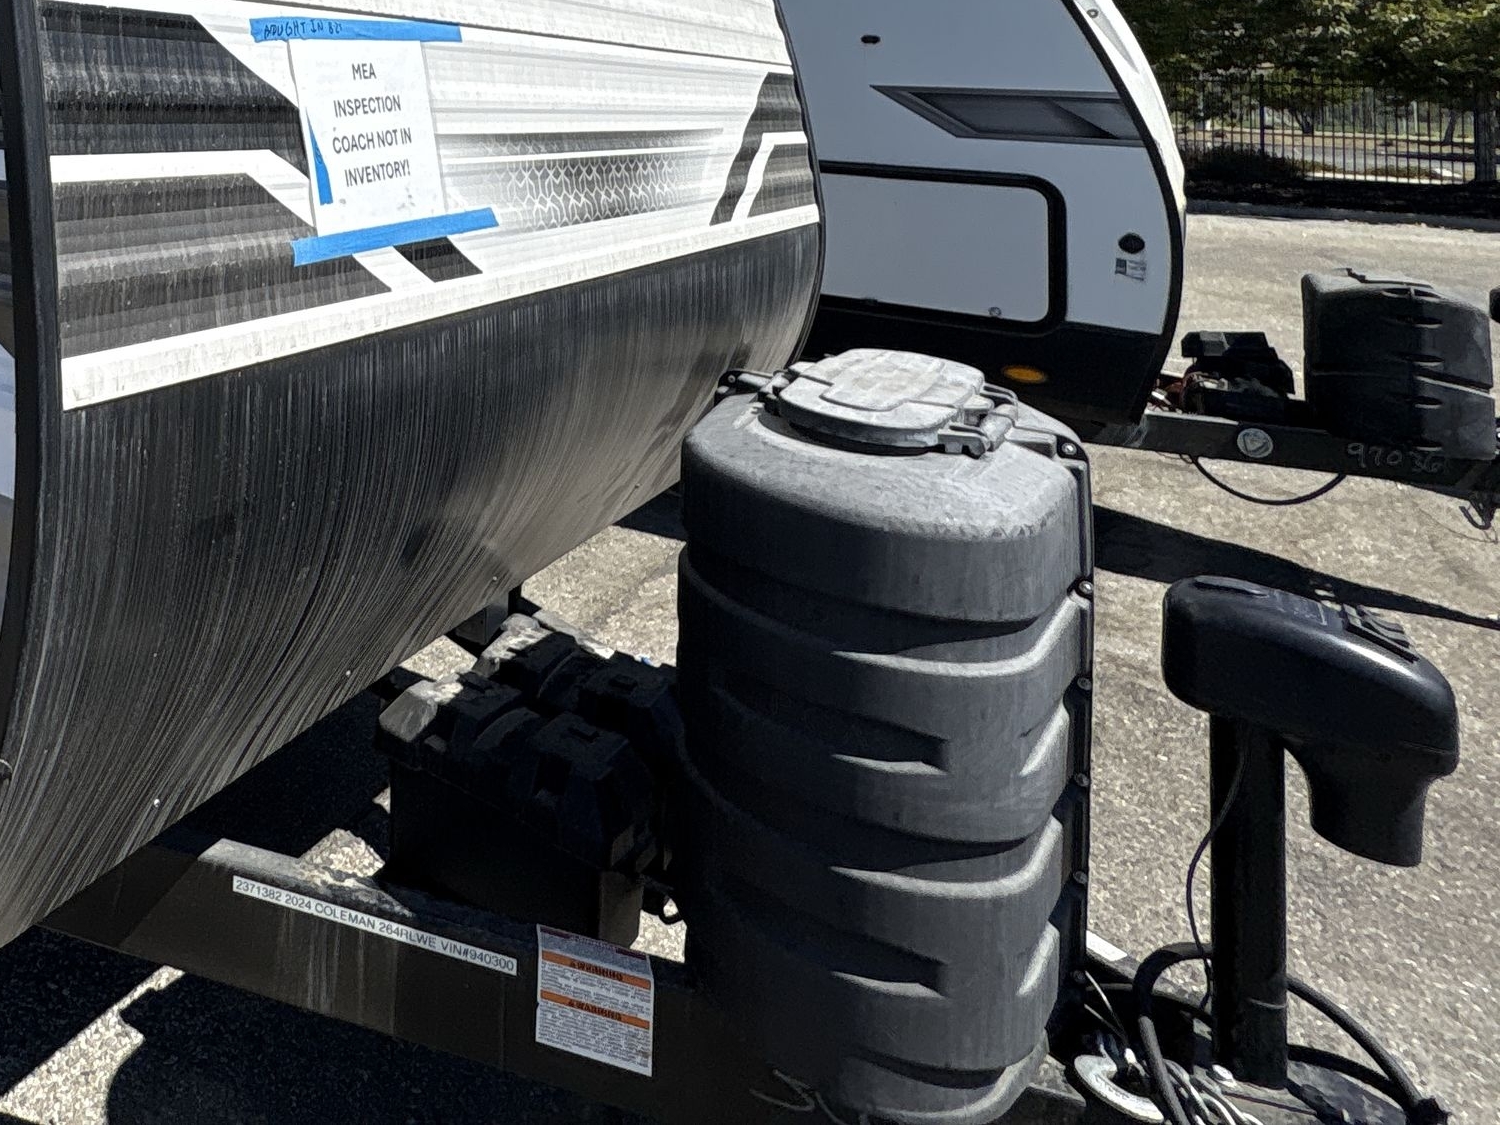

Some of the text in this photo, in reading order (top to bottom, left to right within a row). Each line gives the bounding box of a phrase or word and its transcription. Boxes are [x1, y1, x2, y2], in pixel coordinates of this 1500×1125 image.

[310, 18, 324, 33] IN
[351, 62, 377, 81] MEA
[333, 94, 402, 118] INSPECTION
[332, 127, 412, 154] COACH NOT IN
[344, 159, 411, 187] INVENTORY!
[235, 879, 282, 902] 2371382
[284, 894, 312, 911] 2024
[314, 902, 376, 930] COLEMAN
[378, 921, 437, 948] 264RLWE
